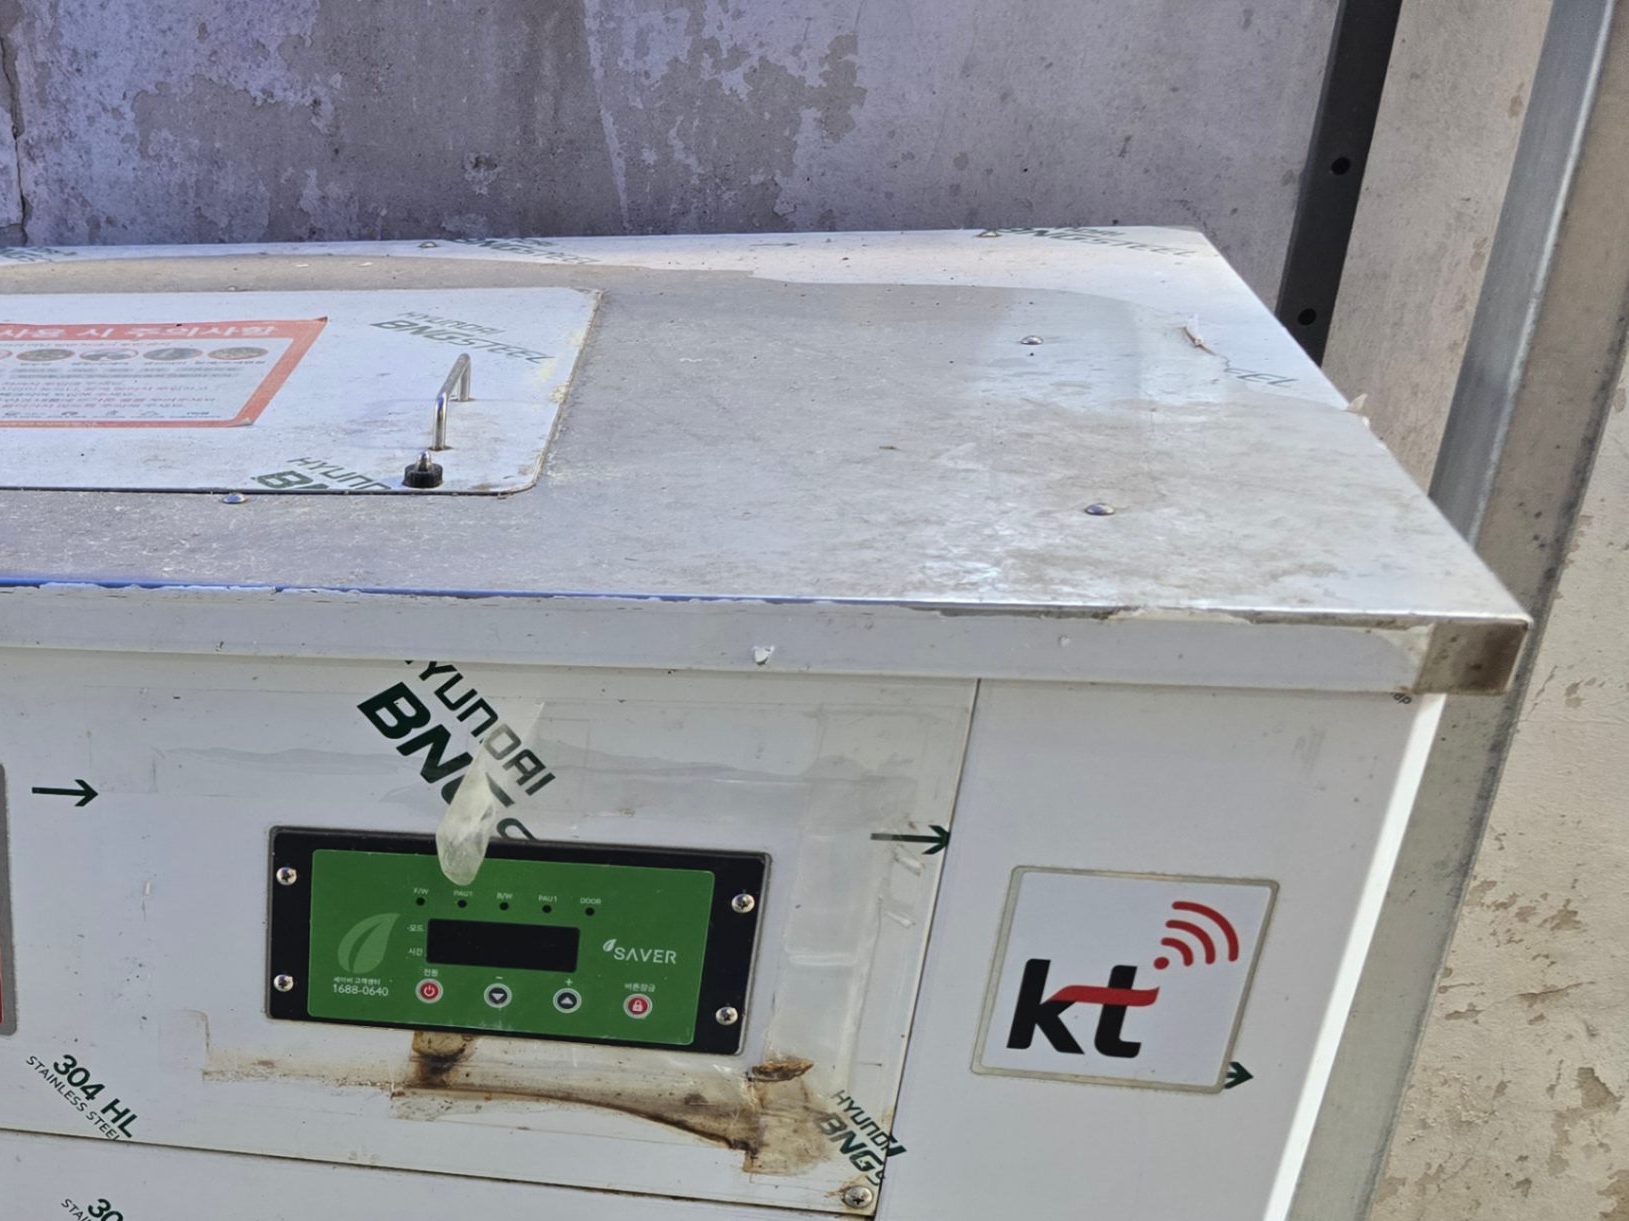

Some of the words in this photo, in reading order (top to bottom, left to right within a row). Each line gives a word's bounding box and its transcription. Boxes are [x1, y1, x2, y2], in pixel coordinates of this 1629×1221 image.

[405, 660, 556, 797] YUNDAI
[333, 984, 389, 997] 1688-0640
[613, 947, 677, 965] SAVER
[1006, 958, 1160, 1059] kt
[25, 1055, 88, 1112] STAINLESS
[53, 1054, 105, 1101] 304
[100, 1098, 138, 1138] HL
